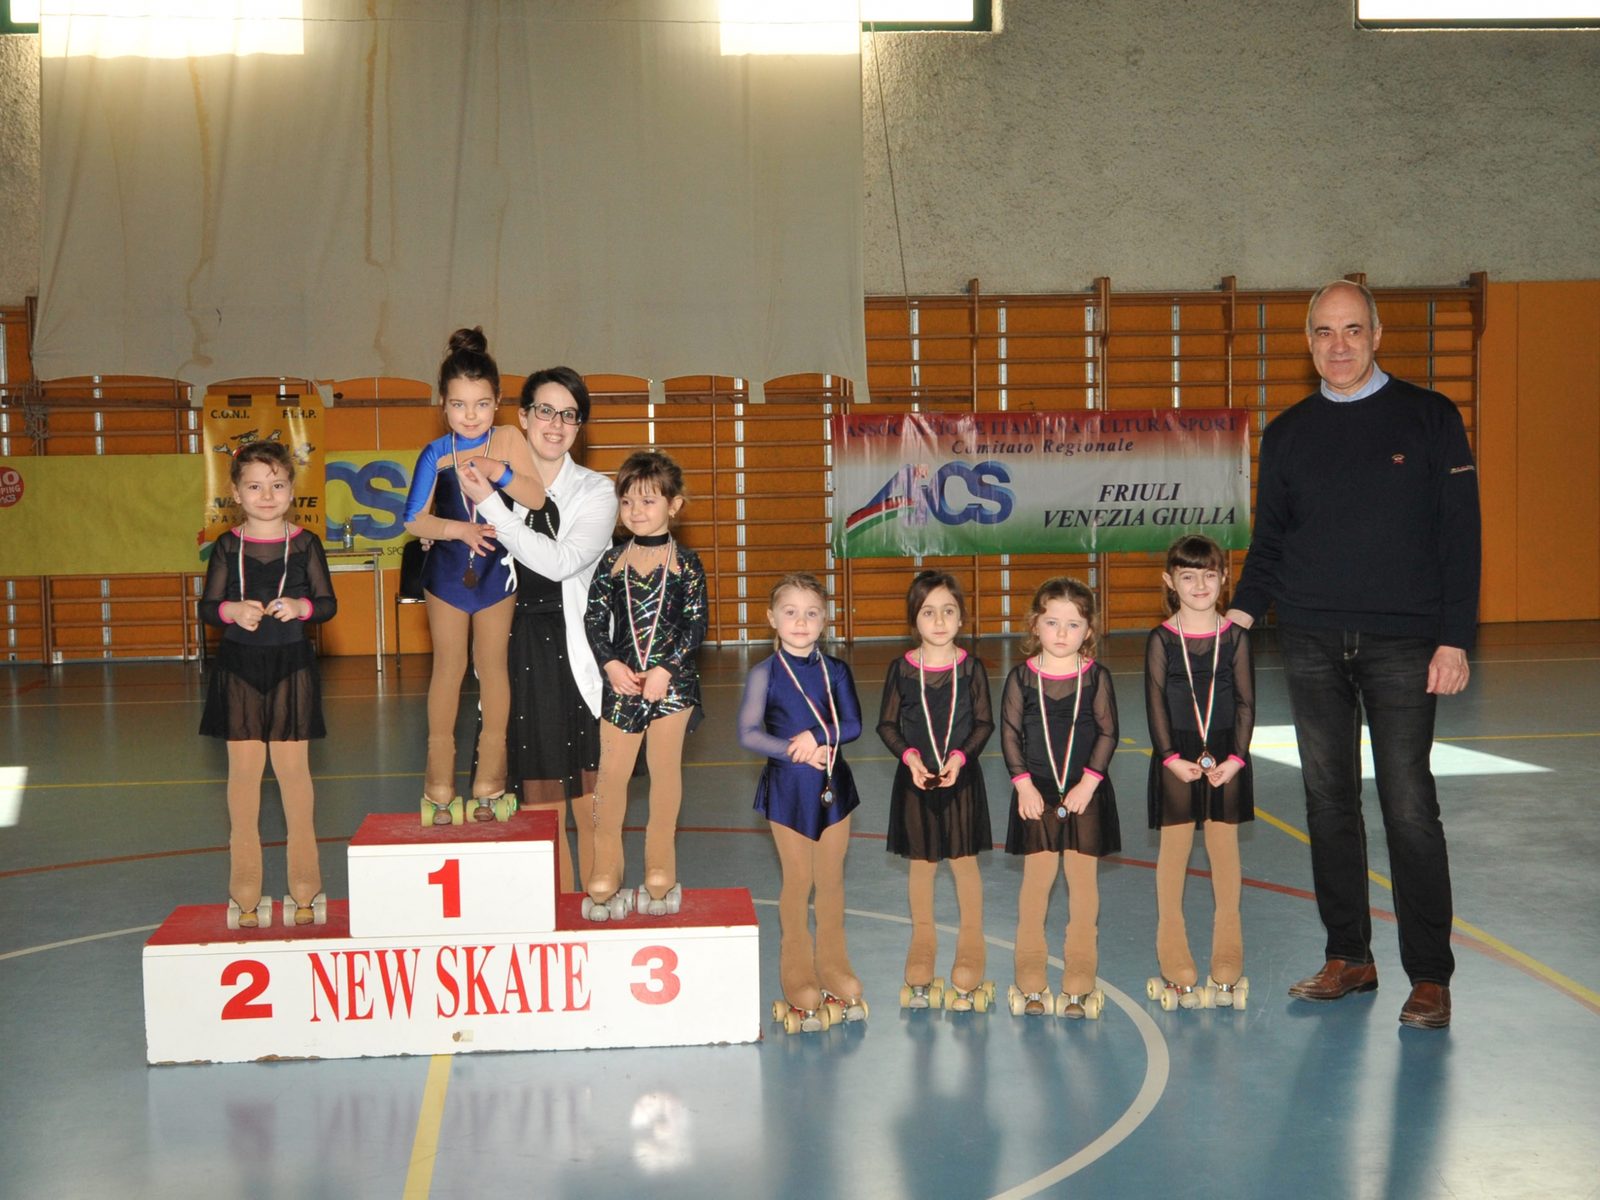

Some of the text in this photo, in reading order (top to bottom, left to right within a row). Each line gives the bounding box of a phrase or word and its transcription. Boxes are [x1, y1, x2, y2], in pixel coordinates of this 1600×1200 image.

[211, 409, 250, 419] C.O.N.I.
[1178, 416, 1237, 432] SPORT
[951, 438, 1134, 457] Comitato Regionale
[325, 459, 409, 541] CS
[1097, 482, 1182, 503] FRIULI
[1044, 506, 1236, 528] VENEZIA GIULIA
[387, 546, 404, 556] SPO
[428, 859, 462, 918] 1
[307, 942, 592, 1023] NEW SKATE
[630, 945, 681, 1005] 3
[220, 960, 273, 1020] 2
